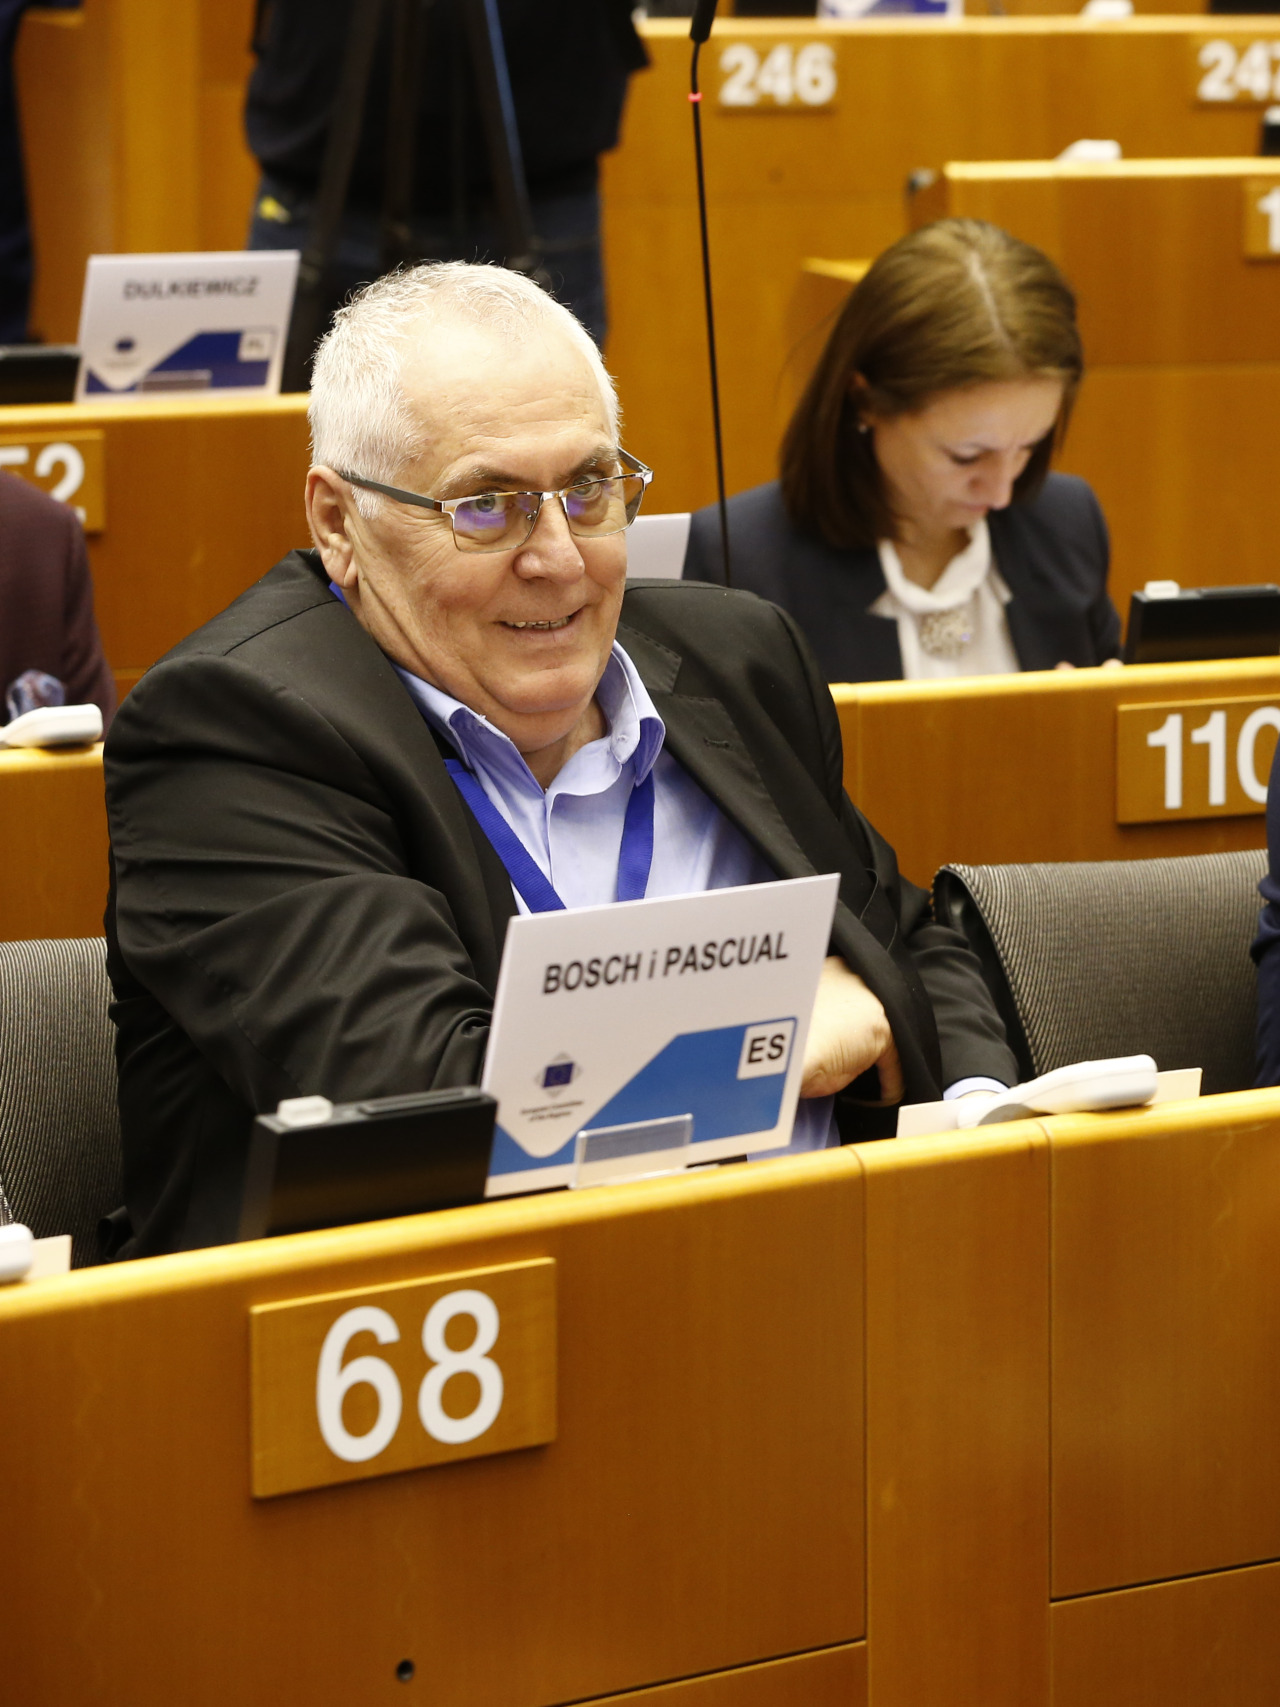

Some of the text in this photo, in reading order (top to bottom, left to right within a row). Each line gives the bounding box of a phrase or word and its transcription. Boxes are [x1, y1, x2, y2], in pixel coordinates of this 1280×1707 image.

[721, 43, 836, 106] 246
[124, 275, 259, 300] DULKIEWICZ
[0, 442, 86, 523] 2
[543, 931, 789, 995] BOSCH i PASCUAL
[746, 1034, 786, 1065] ES
[316, 1290, 504, 1463] 68
